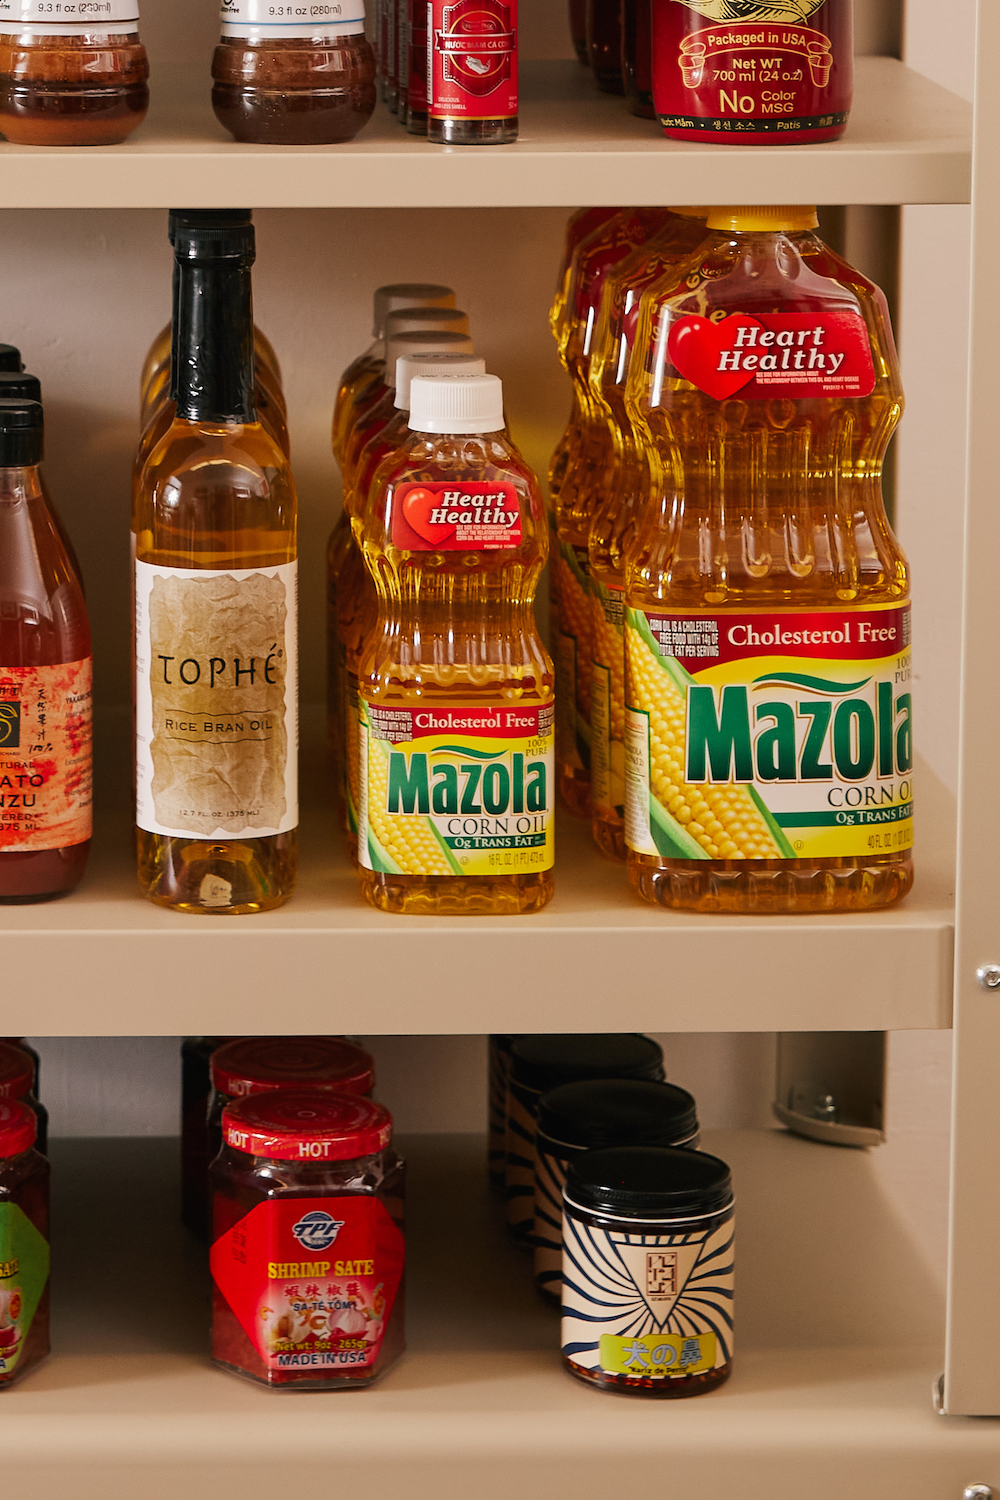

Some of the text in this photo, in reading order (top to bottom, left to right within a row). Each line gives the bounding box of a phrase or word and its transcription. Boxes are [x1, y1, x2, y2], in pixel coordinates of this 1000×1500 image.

[708, 33, 806, 47] Packaged in USA
[732, 58, 783, 69] Net WT
[719, 89, 755, 114] No
[761, 90, 796, 101] Color
[761, 103, 794, 114] MSG
[777, 120, 801, 130] Patis
[734, 326, 825, 348] Heart
[717, 348, 844, 374] Healthy
[441, 491, 505, 507] Heart
[429, 508, 519, 528] Healthy
[728, 622, 896, 646] Cholesterol Free
[165, 719, 273, 732] RICE BRAN OIL
[415, 713, 535, 729] Cholesterol Free
[685, 680, 913, 785] Mazola
[386, 752, 548, 817] Mazola
[827, 784, 894, 808] CORN
[448, 817, 546, 835] CORN OIL
[474, 837, 511, 847] TRANS
[514, 837, 533, 846] FAT
[298, 1142, 332, 1158] HOT
[292, 1220, 345, 1238] TPF
[268, 1259, 374, 1280] SHRIMP SATE
[622, 1338, 702, 1369] 犬の鼻
